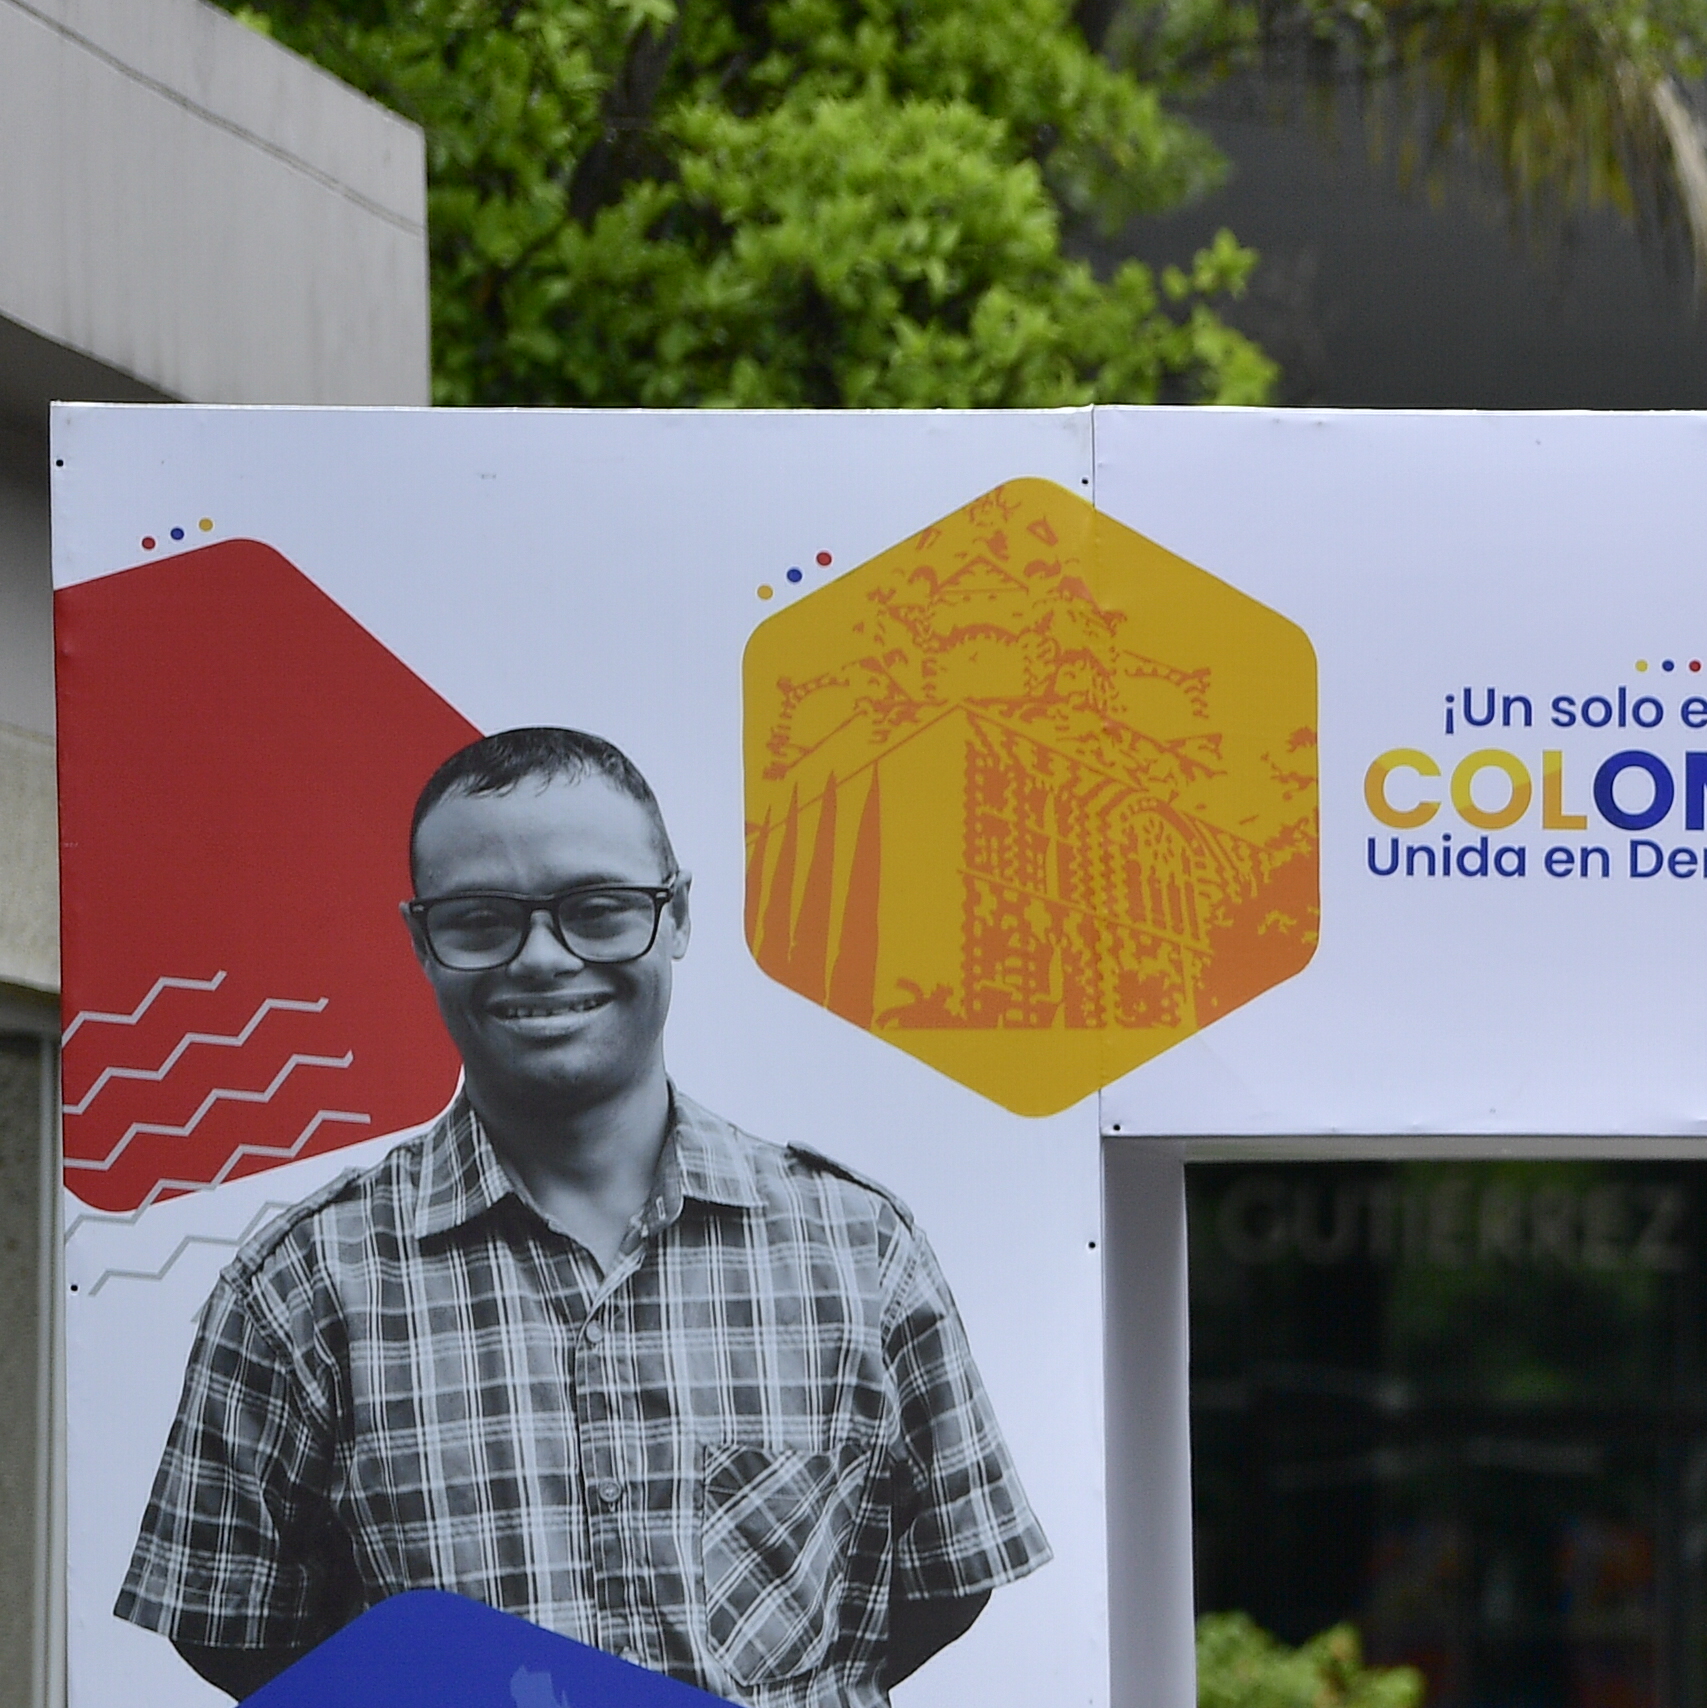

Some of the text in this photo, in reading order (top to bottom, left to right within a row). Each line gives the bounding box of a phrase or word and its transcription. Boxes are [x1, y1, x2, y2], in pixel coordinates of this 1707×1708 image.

[1445, 687, 1534, 735] ¡Un
[1551, 686, 1665, 729] solo
[1367, 834, 1527, 879] Unida
[1545, 846, 1611, 879] en
